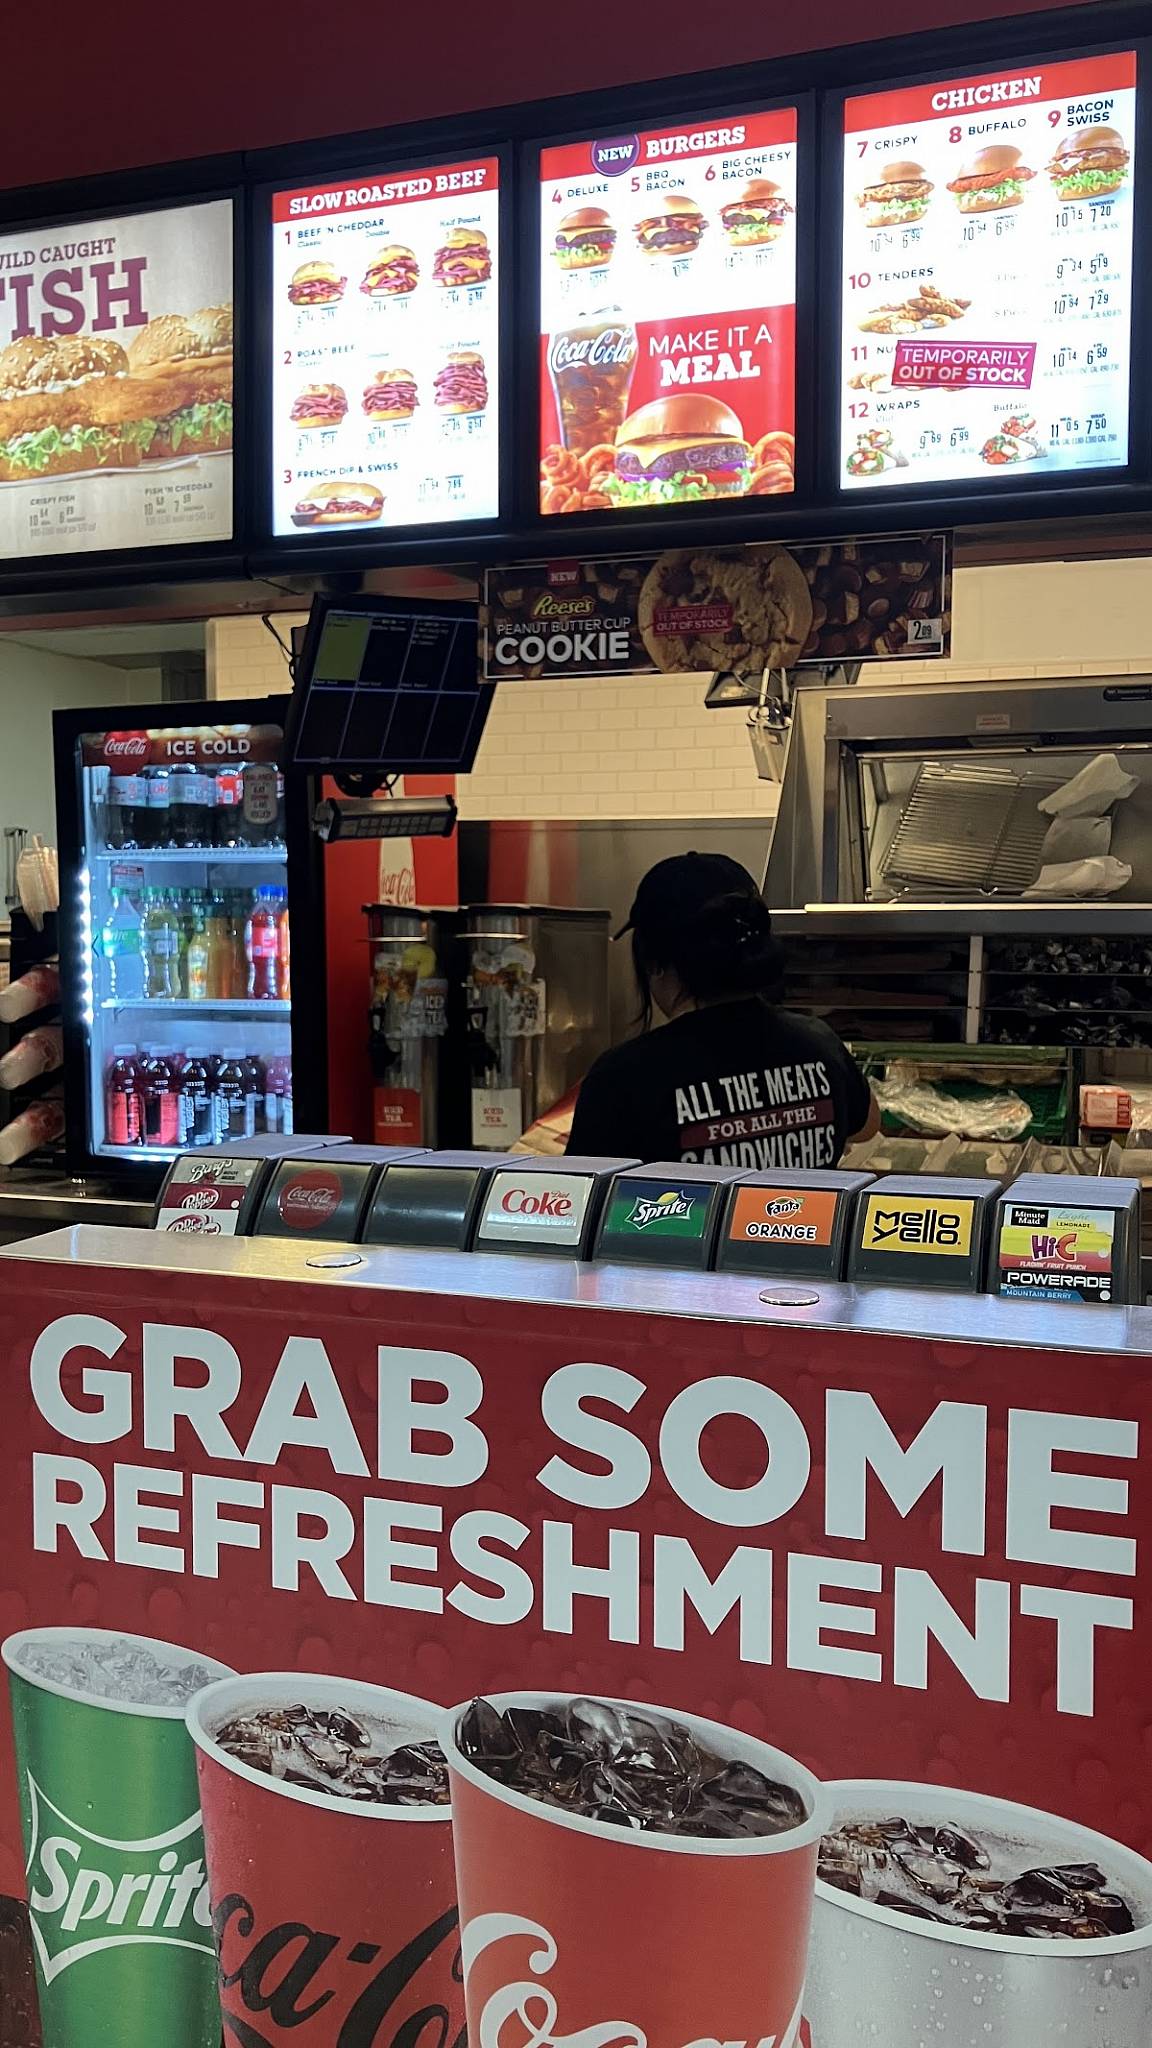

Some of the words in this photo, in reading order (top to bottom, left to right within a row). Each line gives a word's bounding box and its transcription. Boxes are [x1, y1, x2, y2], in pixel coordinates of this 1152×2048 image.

[931, 76, 1042, 112] CHICKEN
[1067, 99, 1114, 115] BACON
[1048, 109, 1061, 127] 9
[1067, 111, 1110, 127] SWISS
[949, 126, 962, 144] 8
[968, 118, 1027, 136] BUFFALO
[646, 126, 746, 159] BURGERS
[857, 140, 869, 158] 7
[874, 135, 918, 151] CRISPY
[597, 144, 634, 162] NEW
[722, 158, 741, 169] BIG
[744, 151, 792, 166] CHEESY
[646, 169, 669, 181] BBQ
[704, 165, 716, 181] 6
[722, 166, 762, 180] BACON
[289, 192, 343, 215] SLOW
[345, 177, 432, 207] ROASTED
[435, 168, 487, 192] BEEF
[551, 189, 562, 204] 4
[567, 183, 609, 198] DELUXE
[630, 177, 640, 192] 5
[646, 178, 686, 191] BACON
[284, 230, 291, 245] 1
[297, 228, 321, 239] BEEF
[337, 218, 385, 233] CHEDDAR
[40, 237, 116, 263] CAUGHT
[849, 272, 871, 289] 10
[878, 267, 934, 282] TENDERS
[0, 256, 149, 342] ISH
[649, 329, 719, 356] MAKE
[727, 326, 749, 348] IT
[755, 324, 773, 345] A
[283, 350, 292, 365] 2
[551, 327, 638, 373] Coca-Cola
[851, 345, 868, 361] 11
[902, 348, 1029, 366] TEMPORARILY
[660, 350, 761, 387] MEAL
[899, 365, 935, 380] OUT
[938, 366, 963, 380] OF
[966, 367, 1026, 382] STOCK
[848, 402, 869, 418] 12
[876, 400, 920, 412] WRAPS
[283, 469, 292, 483] 3
[297, 464, 336, 478] FRENCH
[339, 466, 355, 475] DIP
[367, 462, 399, 472] SWISS
[550, 571, 578, 582] NEW
[534, 595, 595, 616] Reese's
[658, 604, 728, 622] TEMPORARILY
[497, 620, 548, 635] PEANUT
[551, 619, 601, 633] BUTTER
[602, 617, 631, 630] CUP
[656, 622, 678, 632] OUT
[679, 620, 693, 630] OF
[695, 617, 729, 629] STOCK
[495, 631, 630, 665] COOKIE
[104, 738, 147, 756] Coca-Cola
[167, 741, 196, 756] ICE
[202, 739, 251, 755] COLD
[675, 1081, 721, 1125] ALL
[718, 1072, 764, 1113] THE
[764, 1061, 831, 1106] MEATS
[708, 1120, 748, 1141] FOR
[750, 1113, 782, 1132] ALL
[783, 1106, 817, 1126] THE
[195, 1191, 208, 1199] Dr
[288, 1186, 336, 1202] Coca-Cola
[502, 1189, 572, 1217] Coke
[634, 1199, 687, 1222] Sprite
[766, 1199, 800, 1215] Fanta
[1015, 1210, 1046, 1220] Minute
[183, 1218, 197, 1226] Dr
[1018, 1217, 1041, 1225] Maid
[1056, 1221, 1091, 1229] LEMONADE
[746, 1222, 817, 1241] ORANGE
[1047, 1262, 1065, 1270] FRUIT
[1066, 1263, 1087, 1271] PUNCH
[1007, 1271, 1112, 1289] POWERADE
[1006, 1289, 1046, 1298] MOUNTAIN
[1047, 1291, 1073, 1299] BERRY
[30, 1313, 491, 1488] GRAB
[535, 1362, 1140, 1576] SOME
[32, 1452, 1135, 1718] REFRESHMENT
